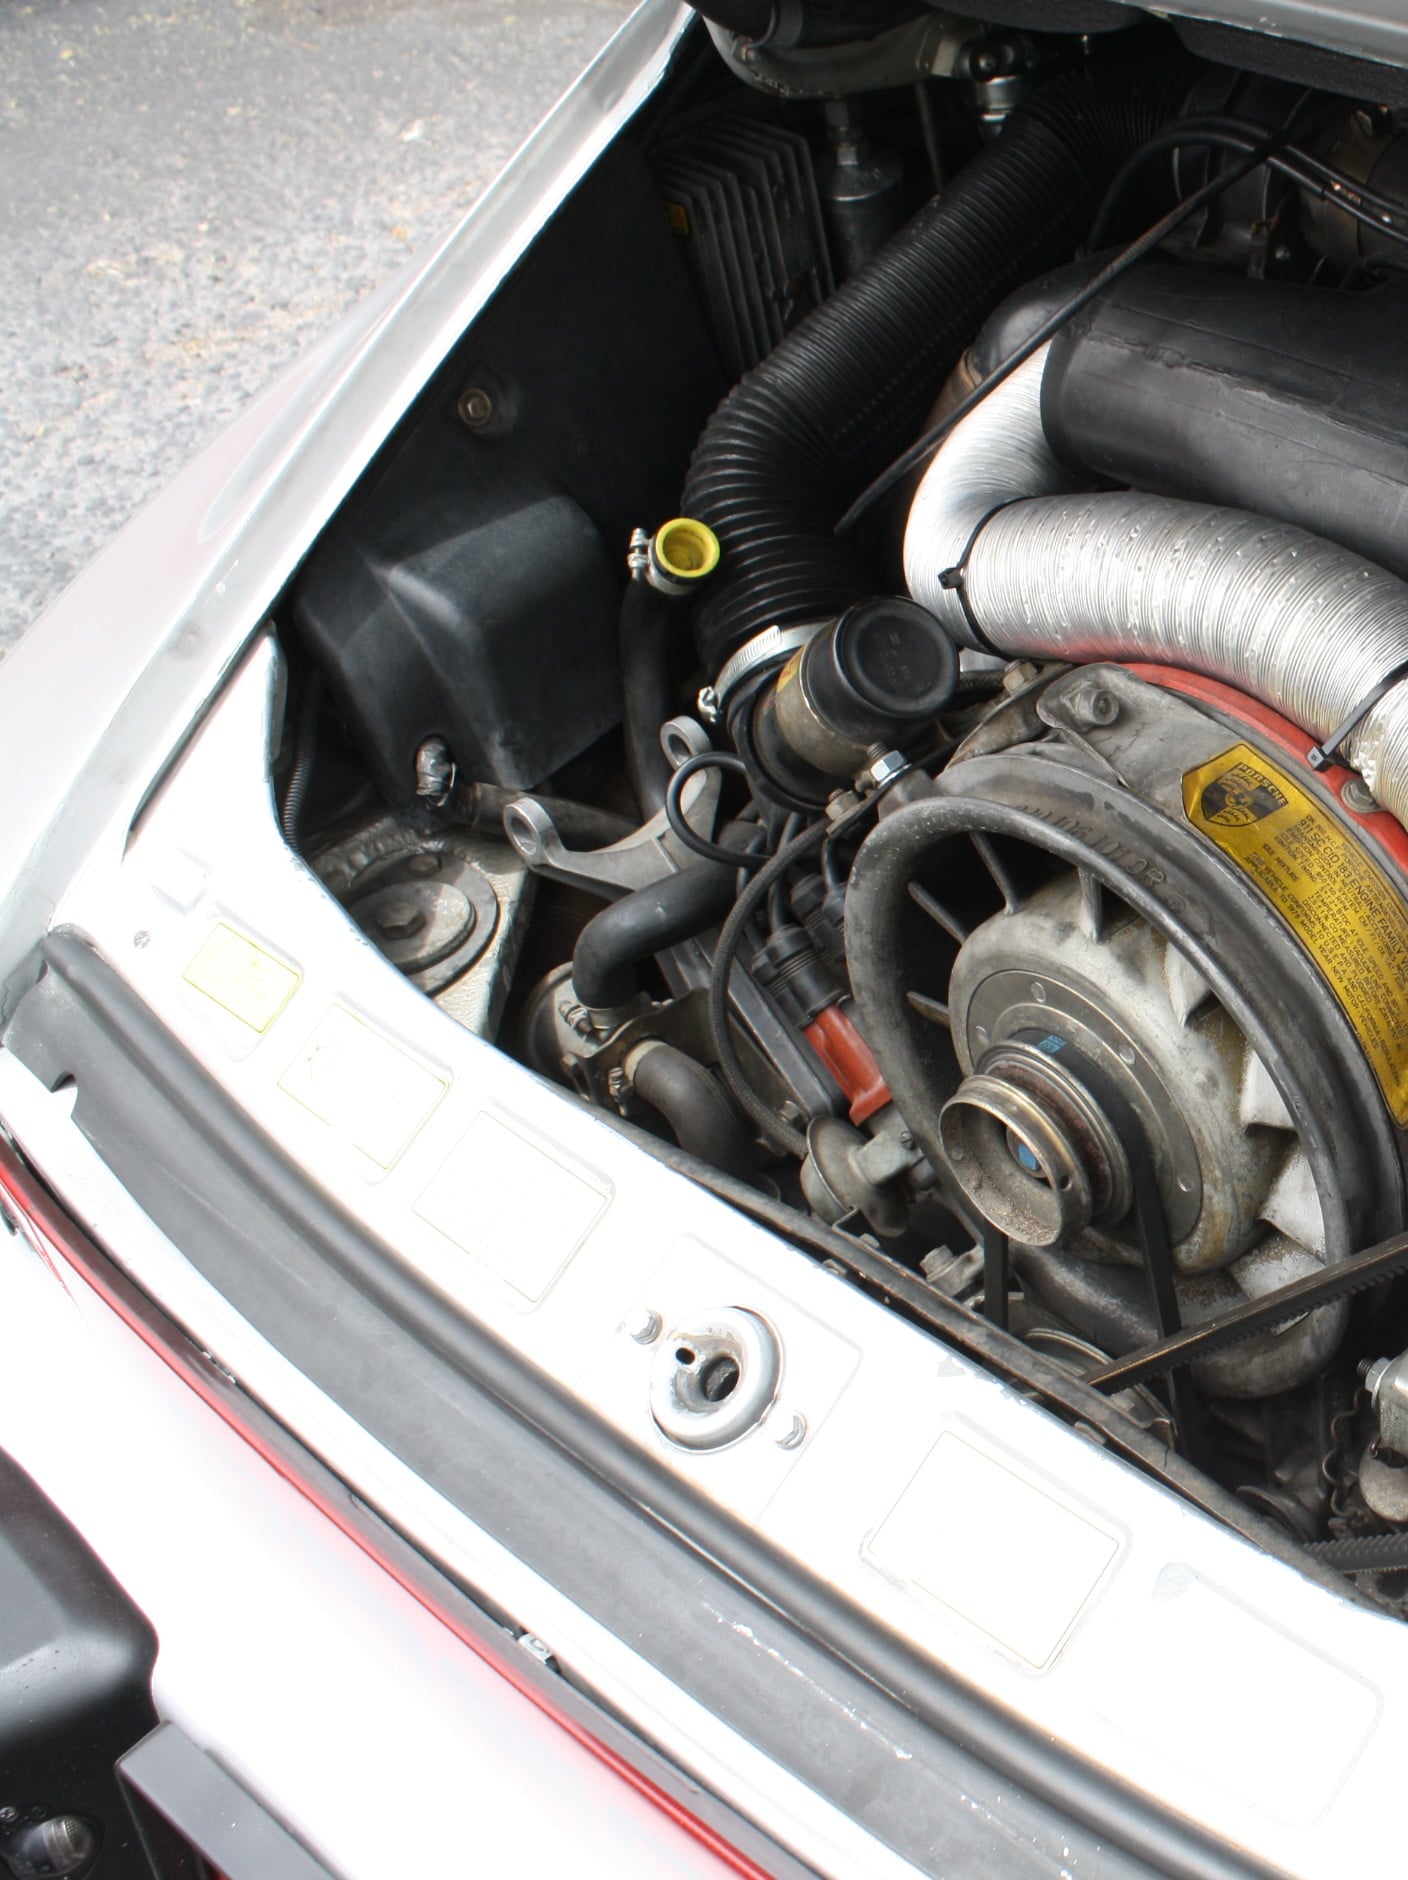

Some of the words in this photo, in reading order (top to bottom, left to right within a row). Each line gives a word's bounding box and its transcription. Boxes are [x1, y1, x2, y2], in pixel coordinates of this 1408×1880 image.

[1237, 763, 1286, 806] PORSCHE
[1297, 818, 1313, 834] 911
[1309, 831, 1326, 848] SC
[1322, 845, 1340, 865] CID
[1336, 861, 1353, 880] 183
[1349, 878, 1380, 918] ENGINE
[1378, 916, 1404, 955] FAMILY
[1337, 886, 1359, 914] SYSTEM
[1301, 898, 1341, 950] DISCONNECTED
[1313, 890, 1351, 940] TEMPERATURE
[1299, 919, 1318, 944] MODEL
[1317, 944, 1332, 964] YEAR
[1336, 934, 1365, 974] MEASURED
